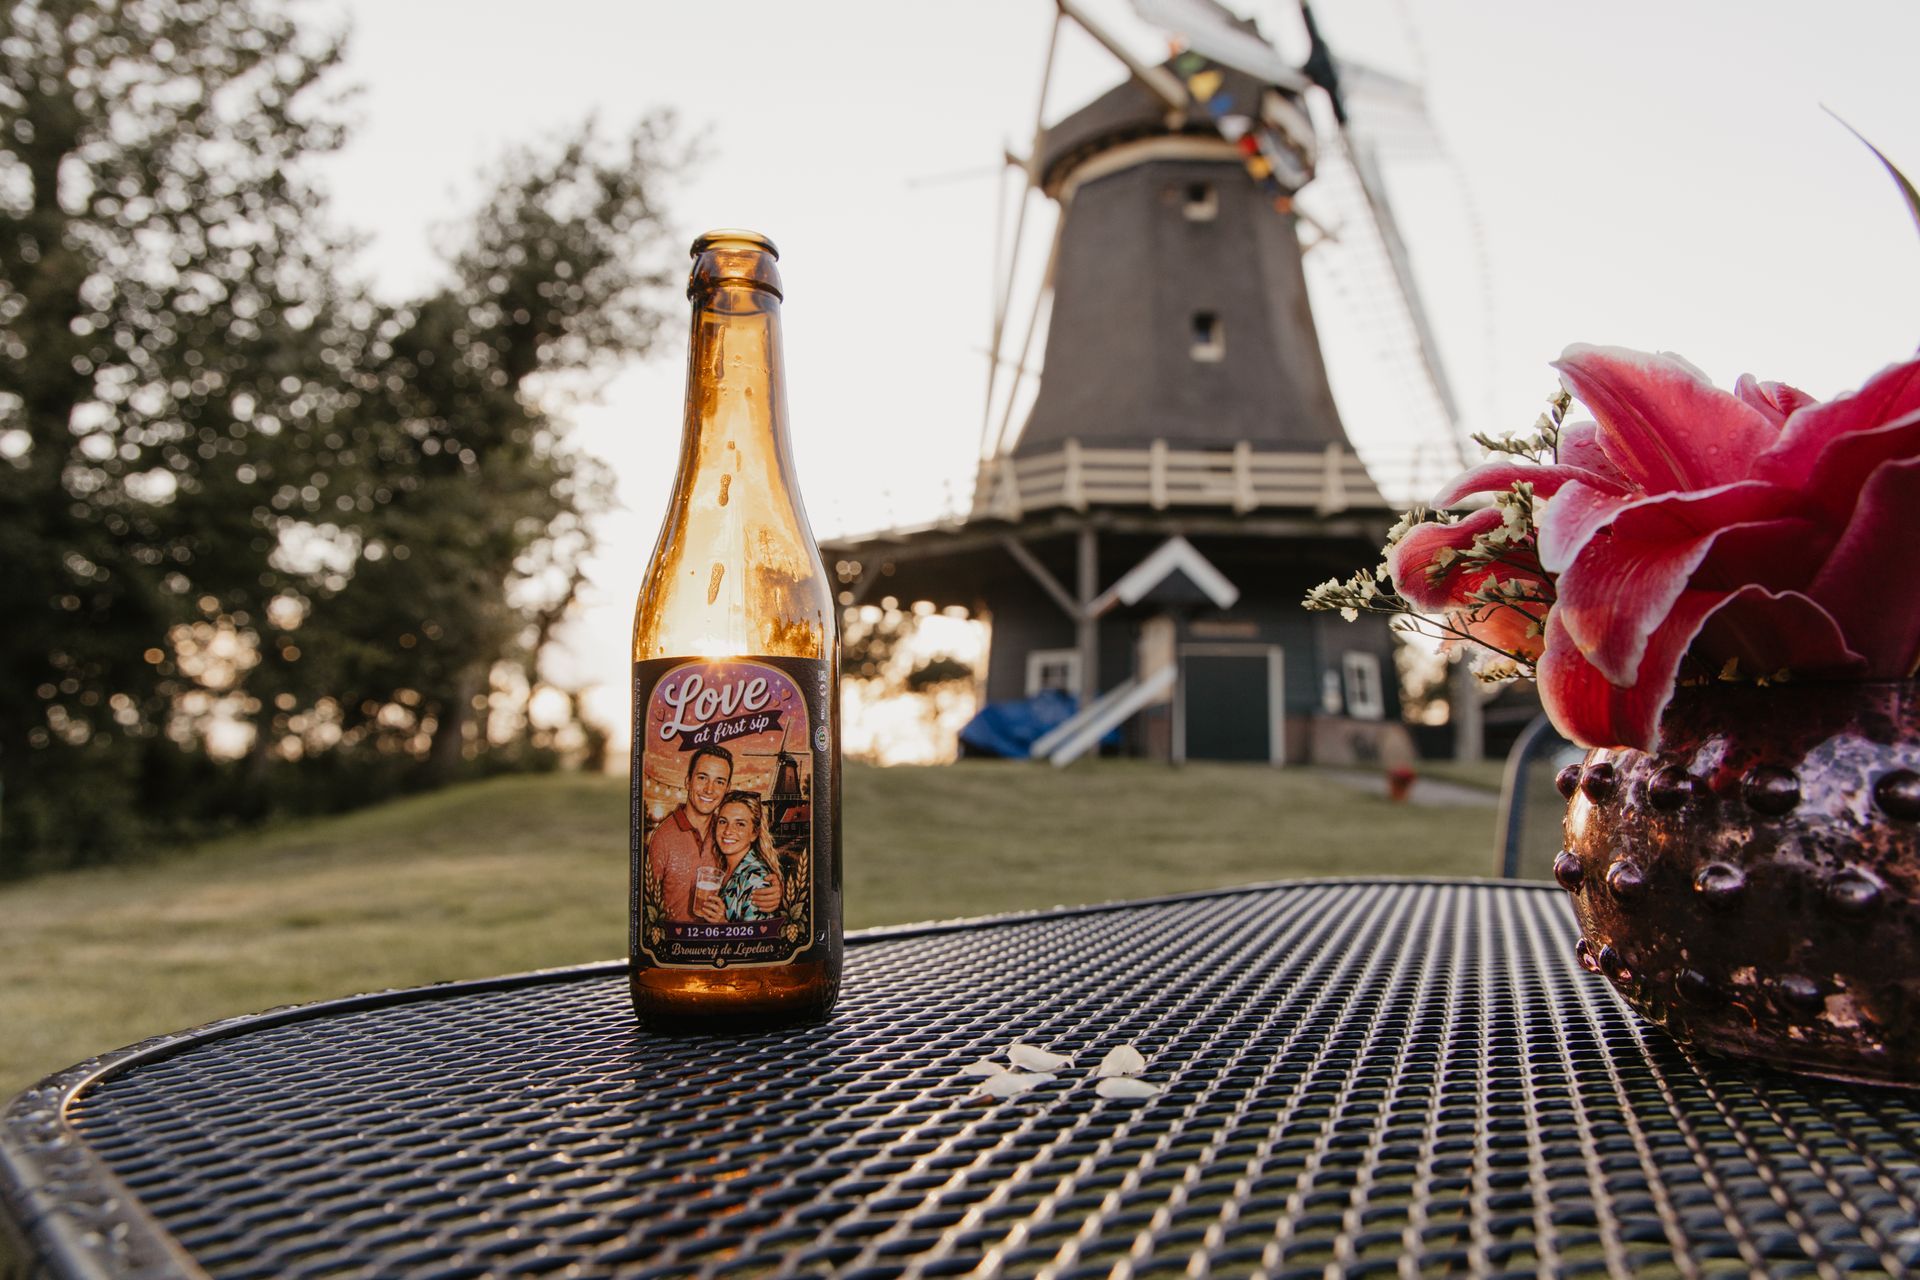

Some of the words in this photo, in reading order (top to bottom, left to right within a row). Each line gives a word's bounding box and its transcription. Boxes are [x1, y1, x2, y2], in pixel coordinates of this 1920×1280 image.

[660, 673, 771, 740] Love
[694, 728, 710, 744] at
[713, 720, 747, 743] first
[749, 714, 770, 734] sip
[687, 926, 754, 937] 12-06-2026
[671, 942, 719, 958] Brouwerij
[720, 943, 732, 955] de
[733, 941, 775, 958] Lepelaer
